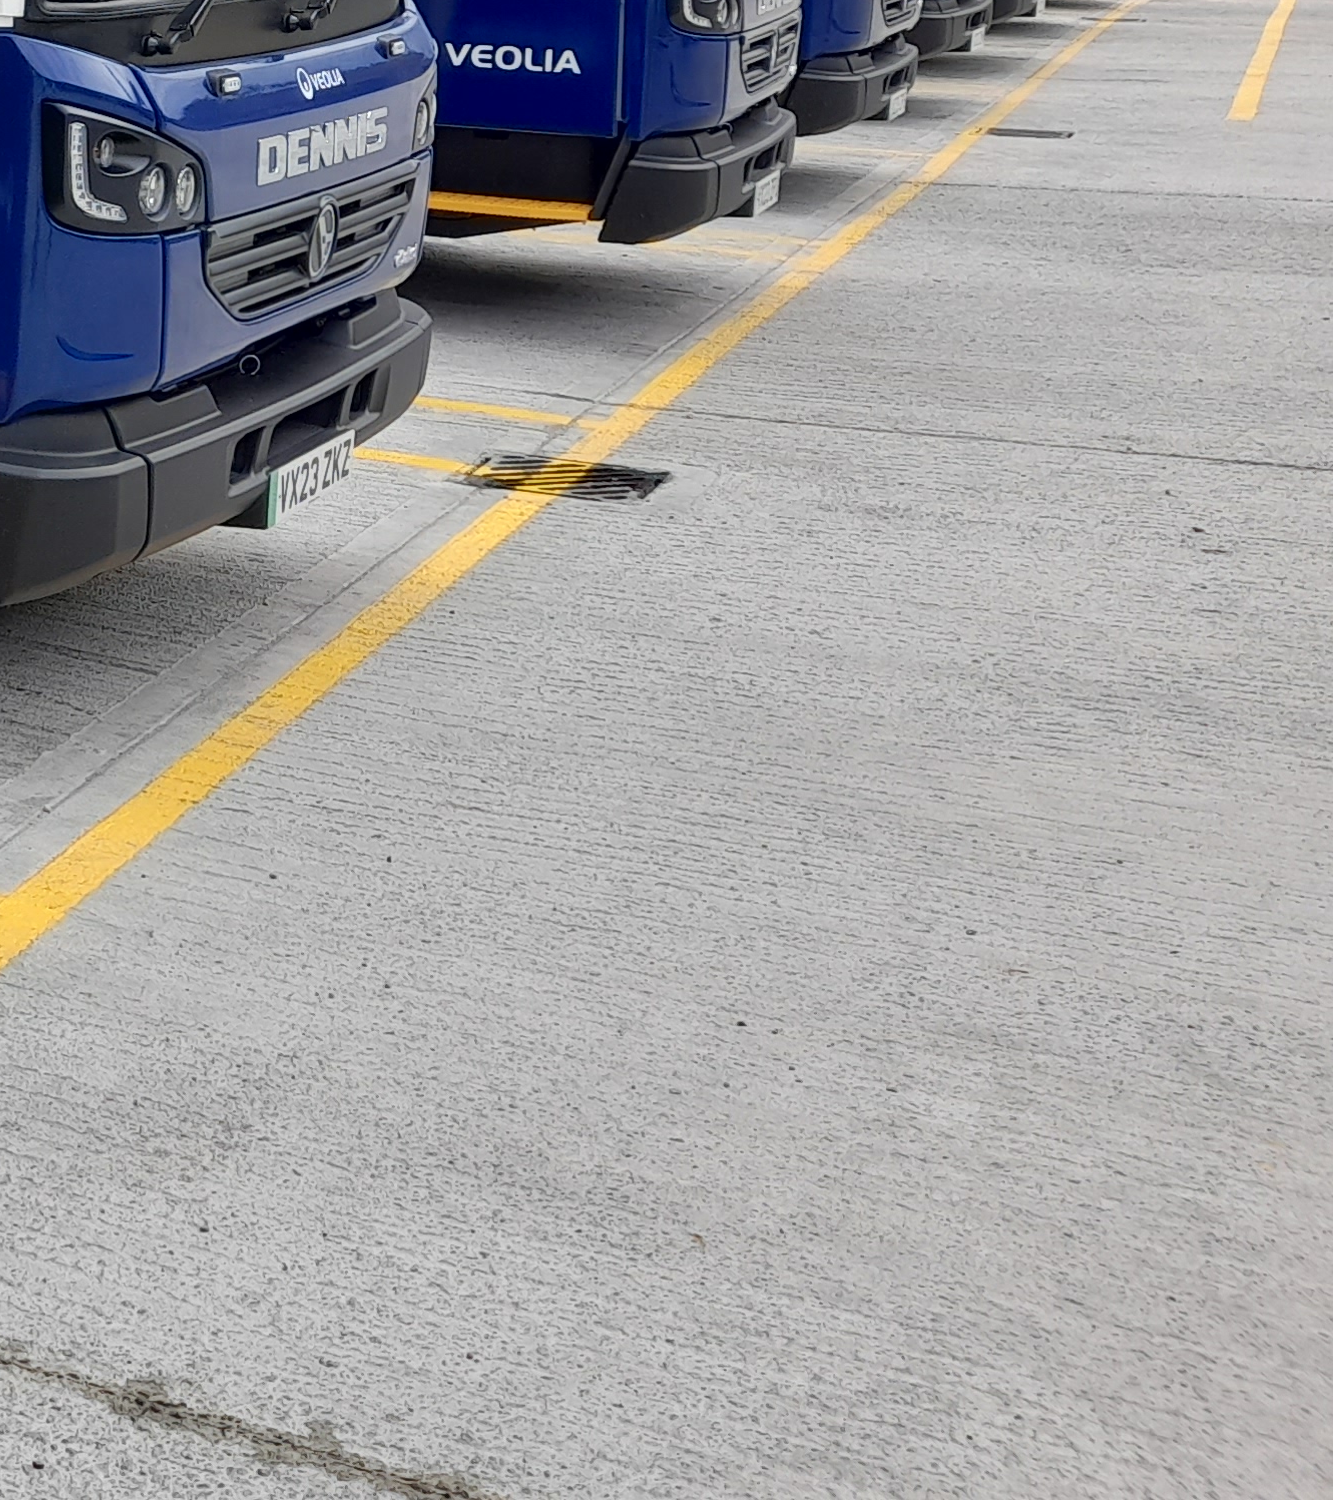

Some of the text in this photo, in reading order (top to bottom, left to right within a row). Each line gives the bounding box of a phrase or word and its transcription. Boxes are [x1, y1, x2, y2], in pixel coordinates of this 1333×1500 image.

[309, 68, 345, 92] VEOLIA
[445, 42, 581, 75] VEOLIA
[256, 105, 388, 186] DENNIS
[282, 440, 351, 513] VX23 ZKZ
